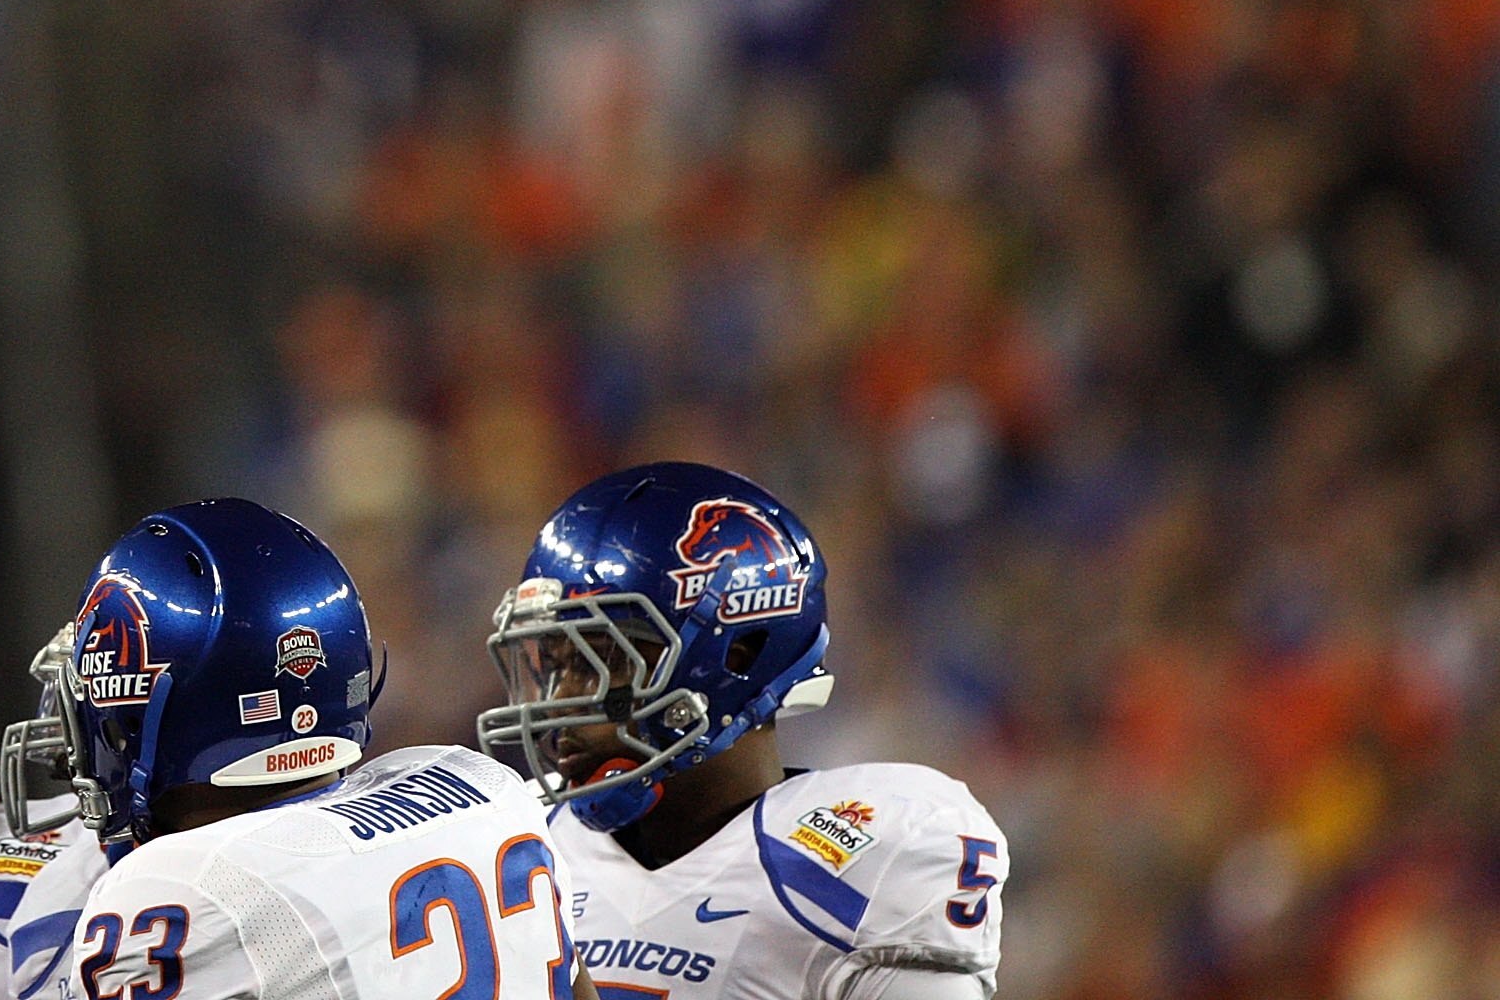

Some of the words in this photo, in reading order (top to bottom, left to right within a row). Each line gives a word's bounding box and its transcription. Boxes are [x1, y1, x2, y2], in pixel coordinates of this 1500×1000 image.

[725, 584, 798, 615] STATE
[283, 636, 315, 651] BOWL
[81, 650, 116, 676] OISE
[92, 673, 151, 699] STATE
[297, 710, 314, 729] 23
[266, 743, 335, 772] BRONCOS
[318, 766, 491, 841] JOHNSON
[946, 834, 998, 929] 5
[81, 904, 190, 1000] 23
[574, 939, 716, 983] ONCOS
